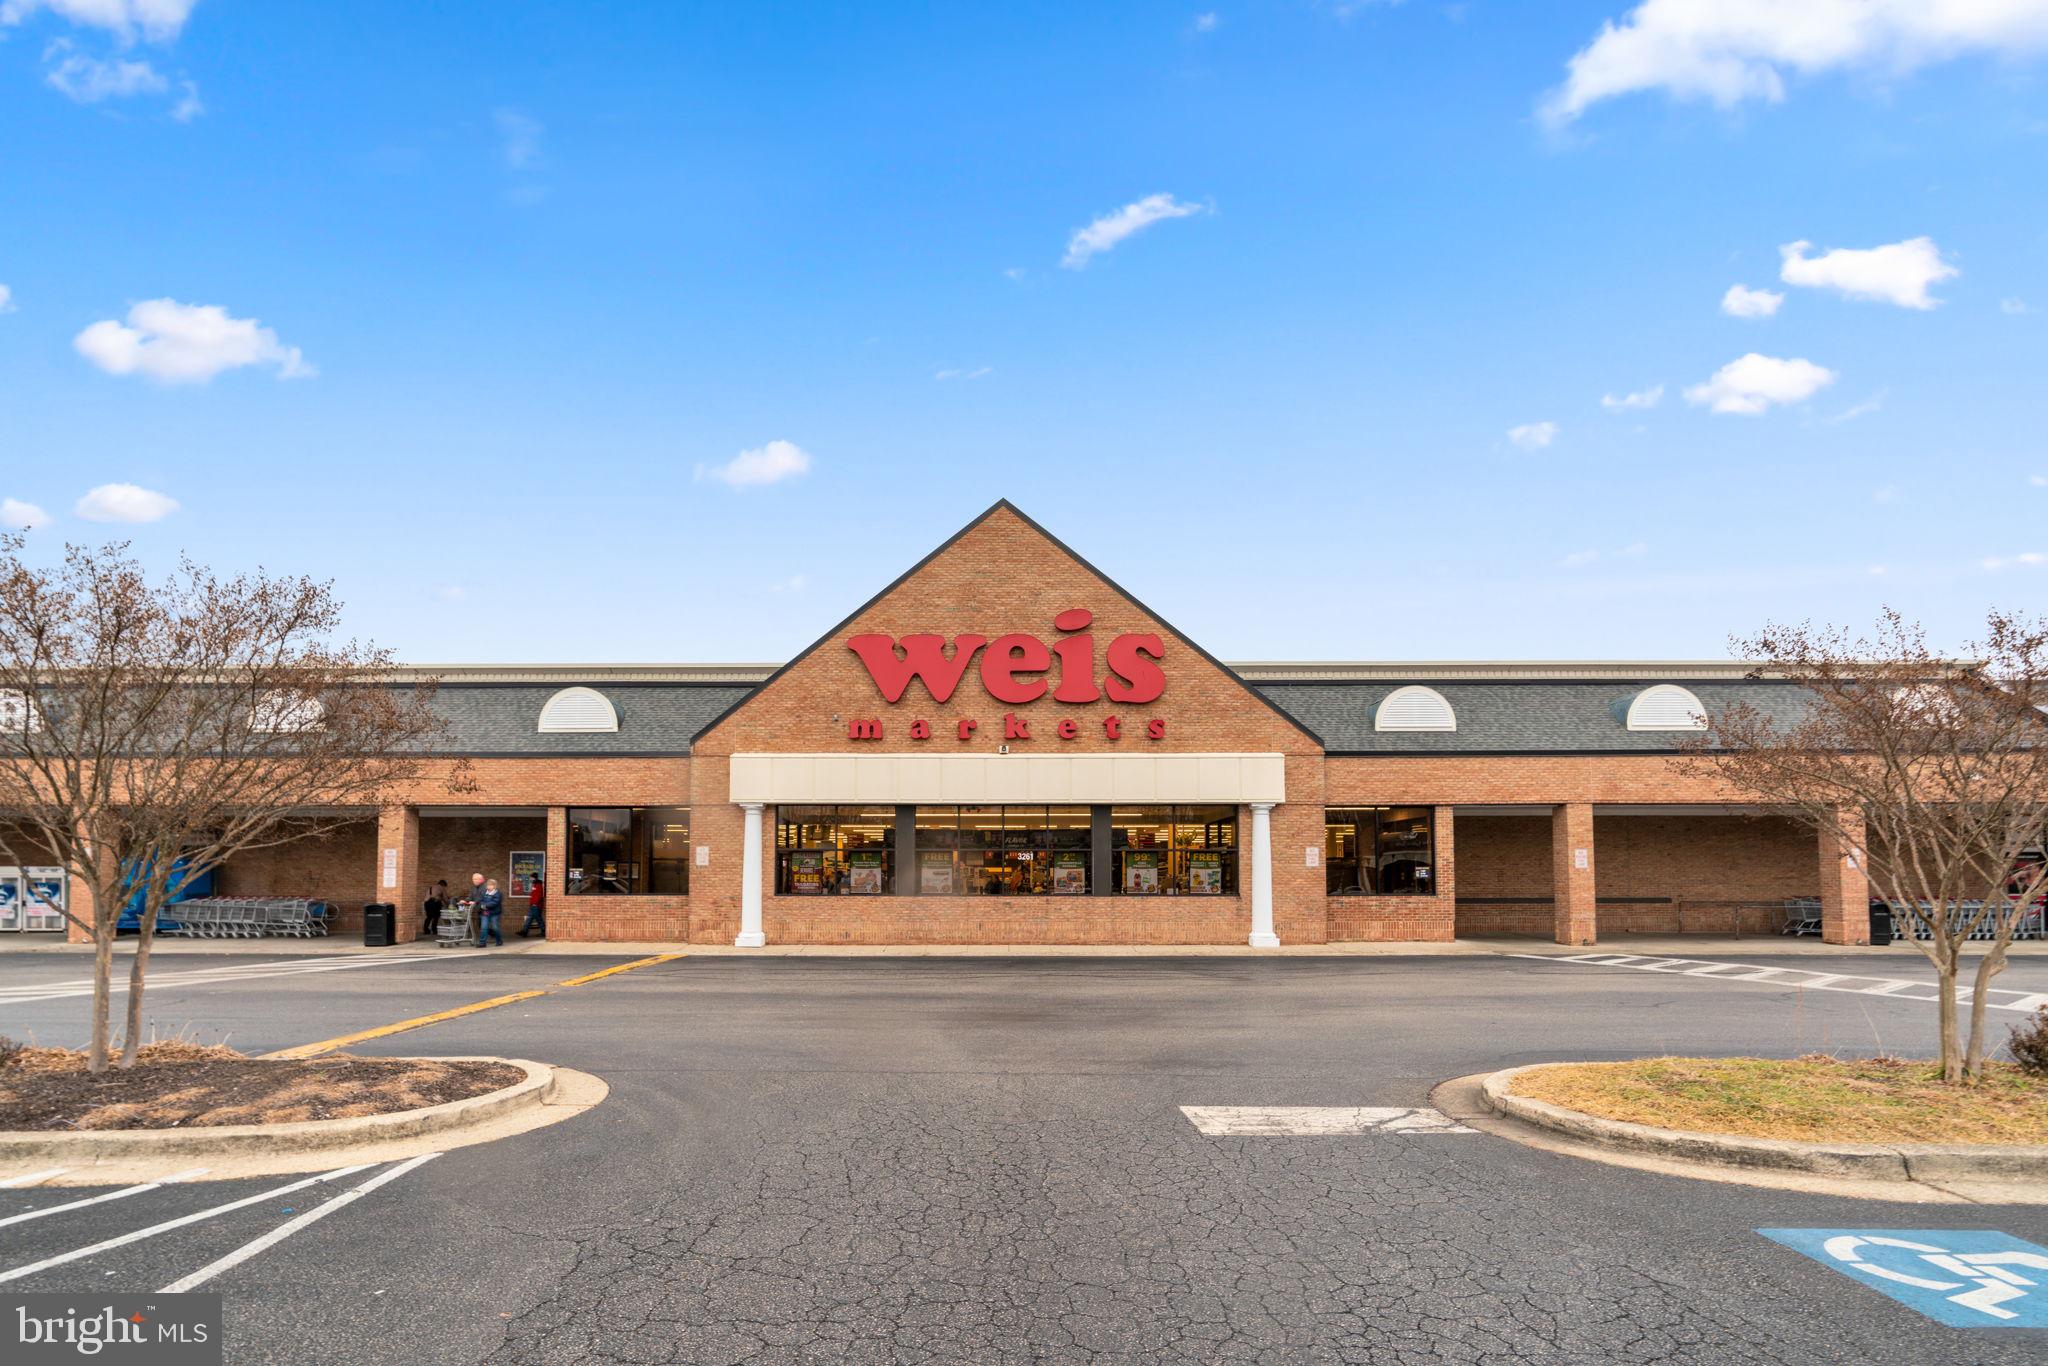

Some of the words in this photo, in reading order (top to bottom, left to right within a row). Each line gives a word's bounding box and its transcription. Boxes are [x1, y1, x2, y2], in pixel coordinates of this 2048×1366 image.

[846, 608, 1168, 703] weis
[847, 712, 1166, 740] markets
[924, 852, 950, 861] FREE
[1017, 850, 1034, 861] 3261
[1193, 853, 1218, 861] FREE
[794, 874, 820, 883] FREE
